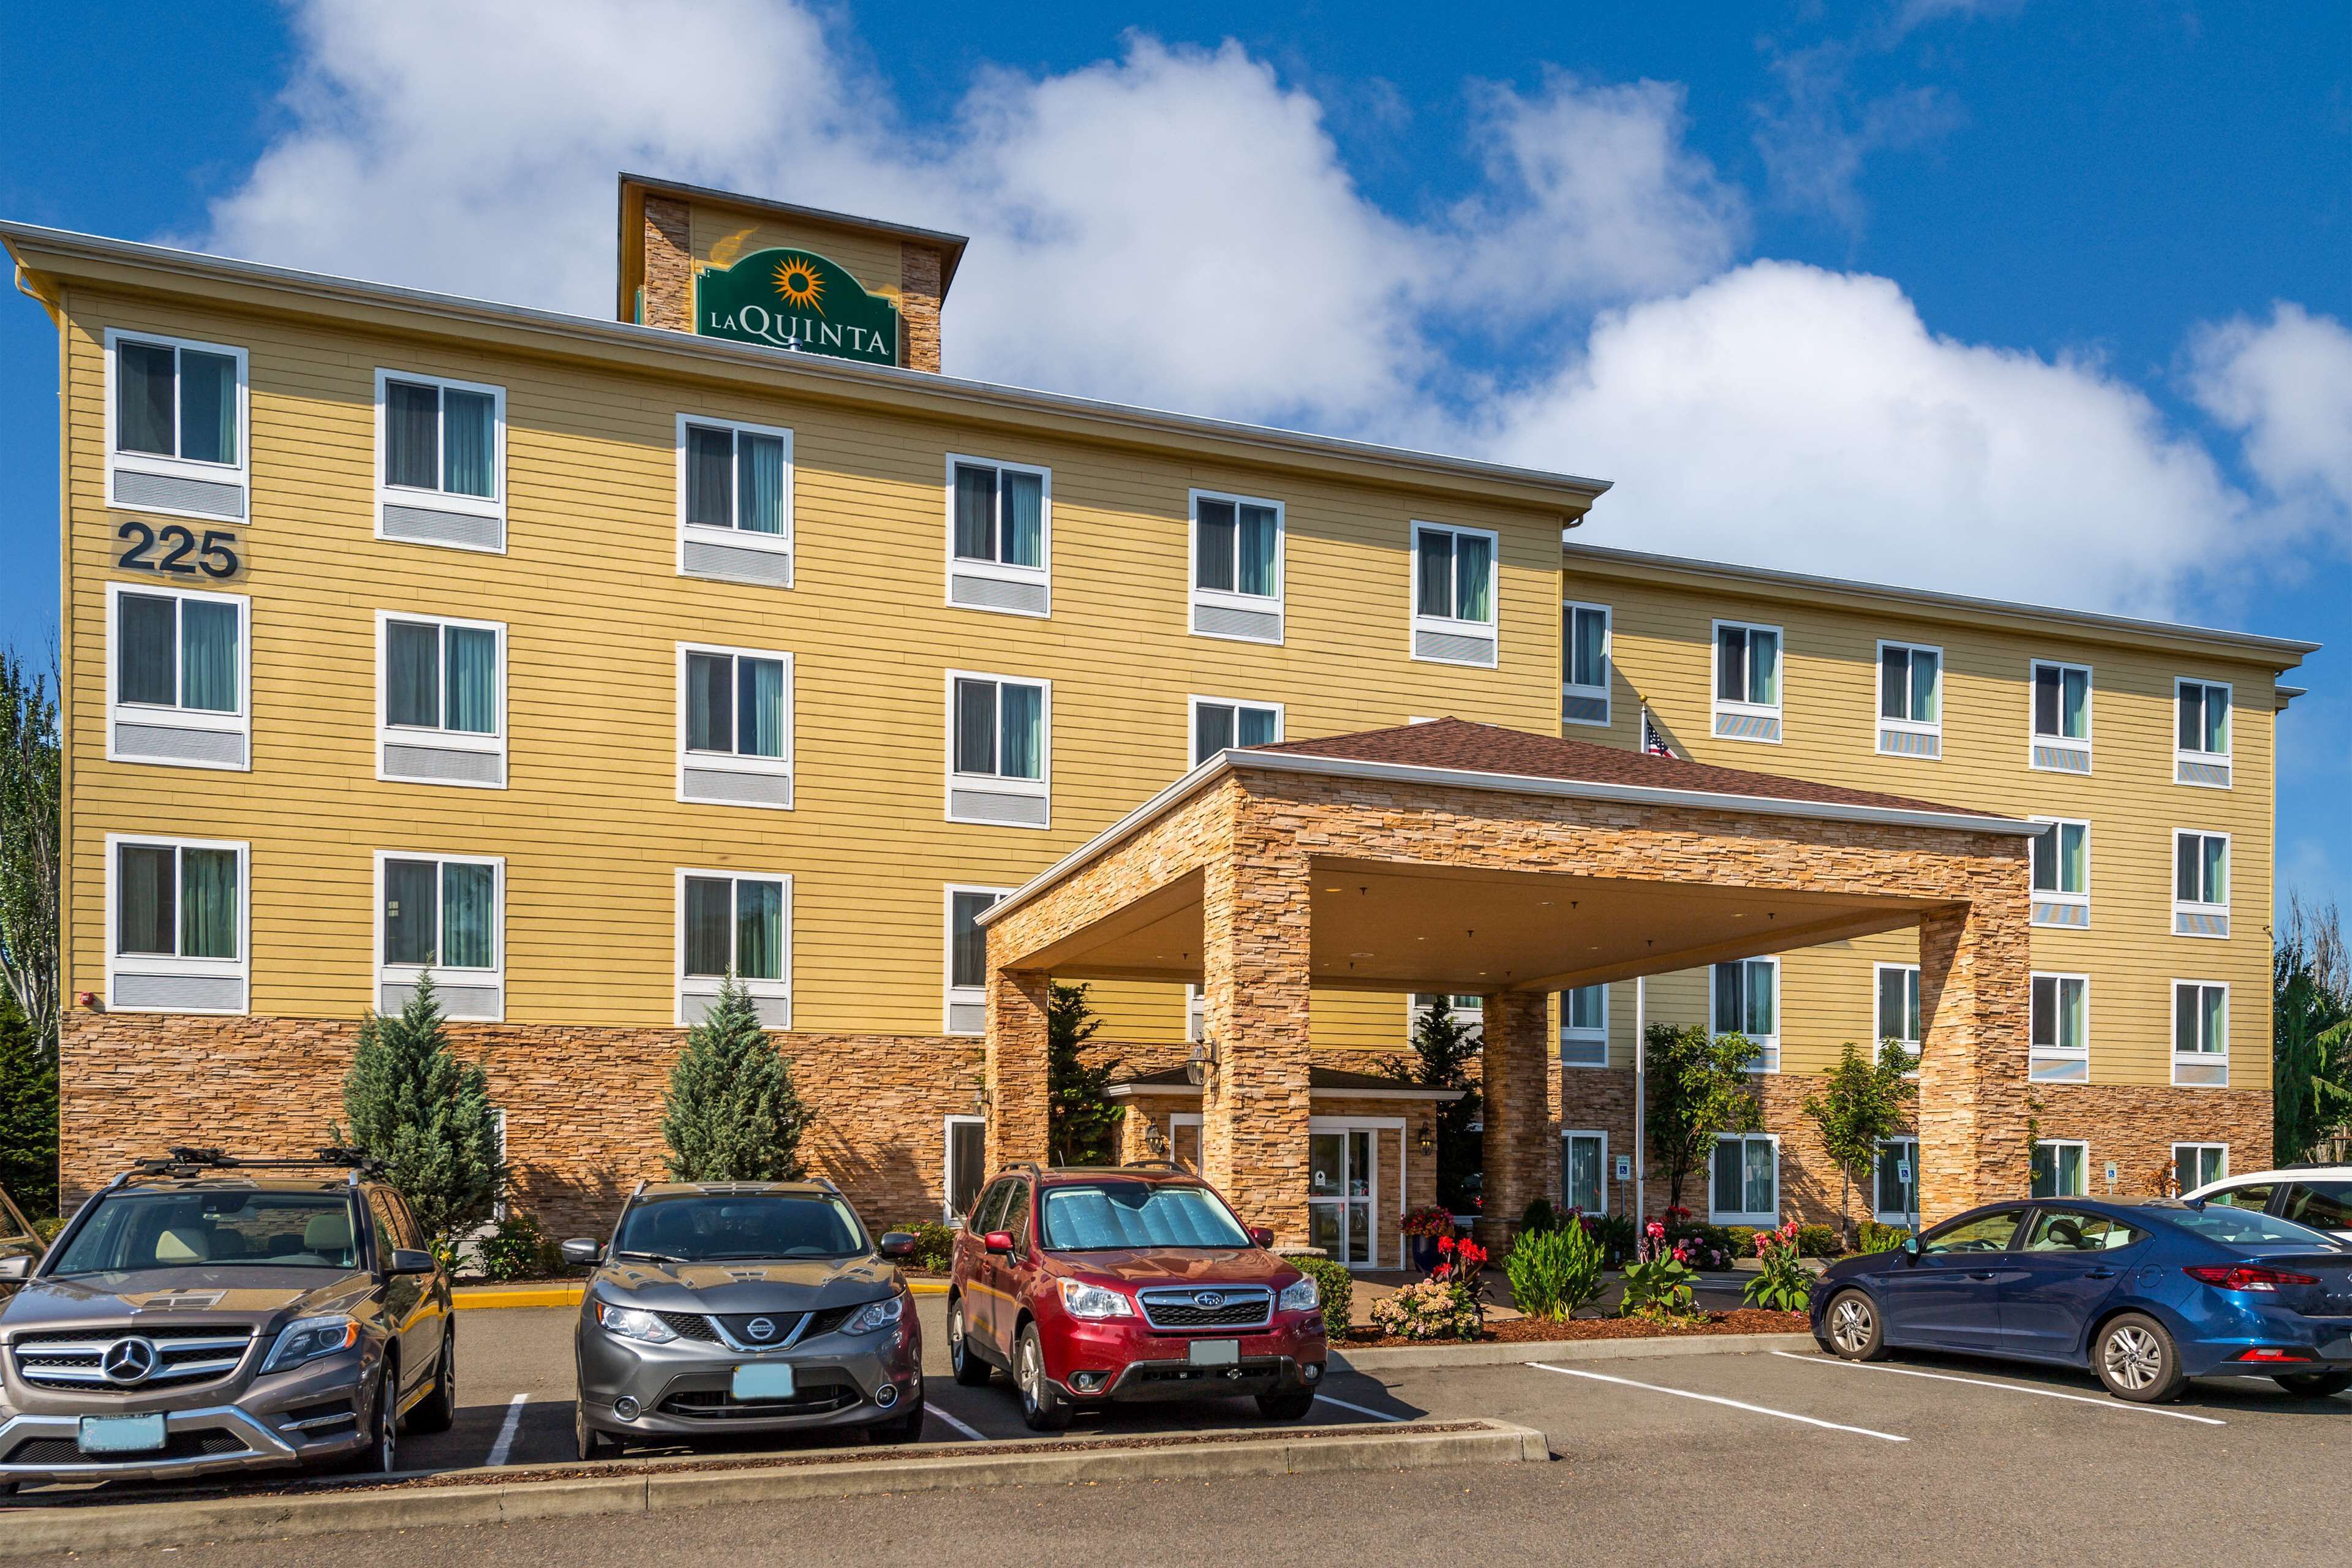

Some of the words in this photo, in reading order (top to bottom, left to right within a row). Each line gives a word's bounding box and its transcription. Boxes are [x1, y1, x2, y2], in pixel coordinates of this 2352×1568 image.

[710, 312, 737, 331] LA
[739, 305, 888, 355] QUINTA
[118, 521, 238, 578] 225
